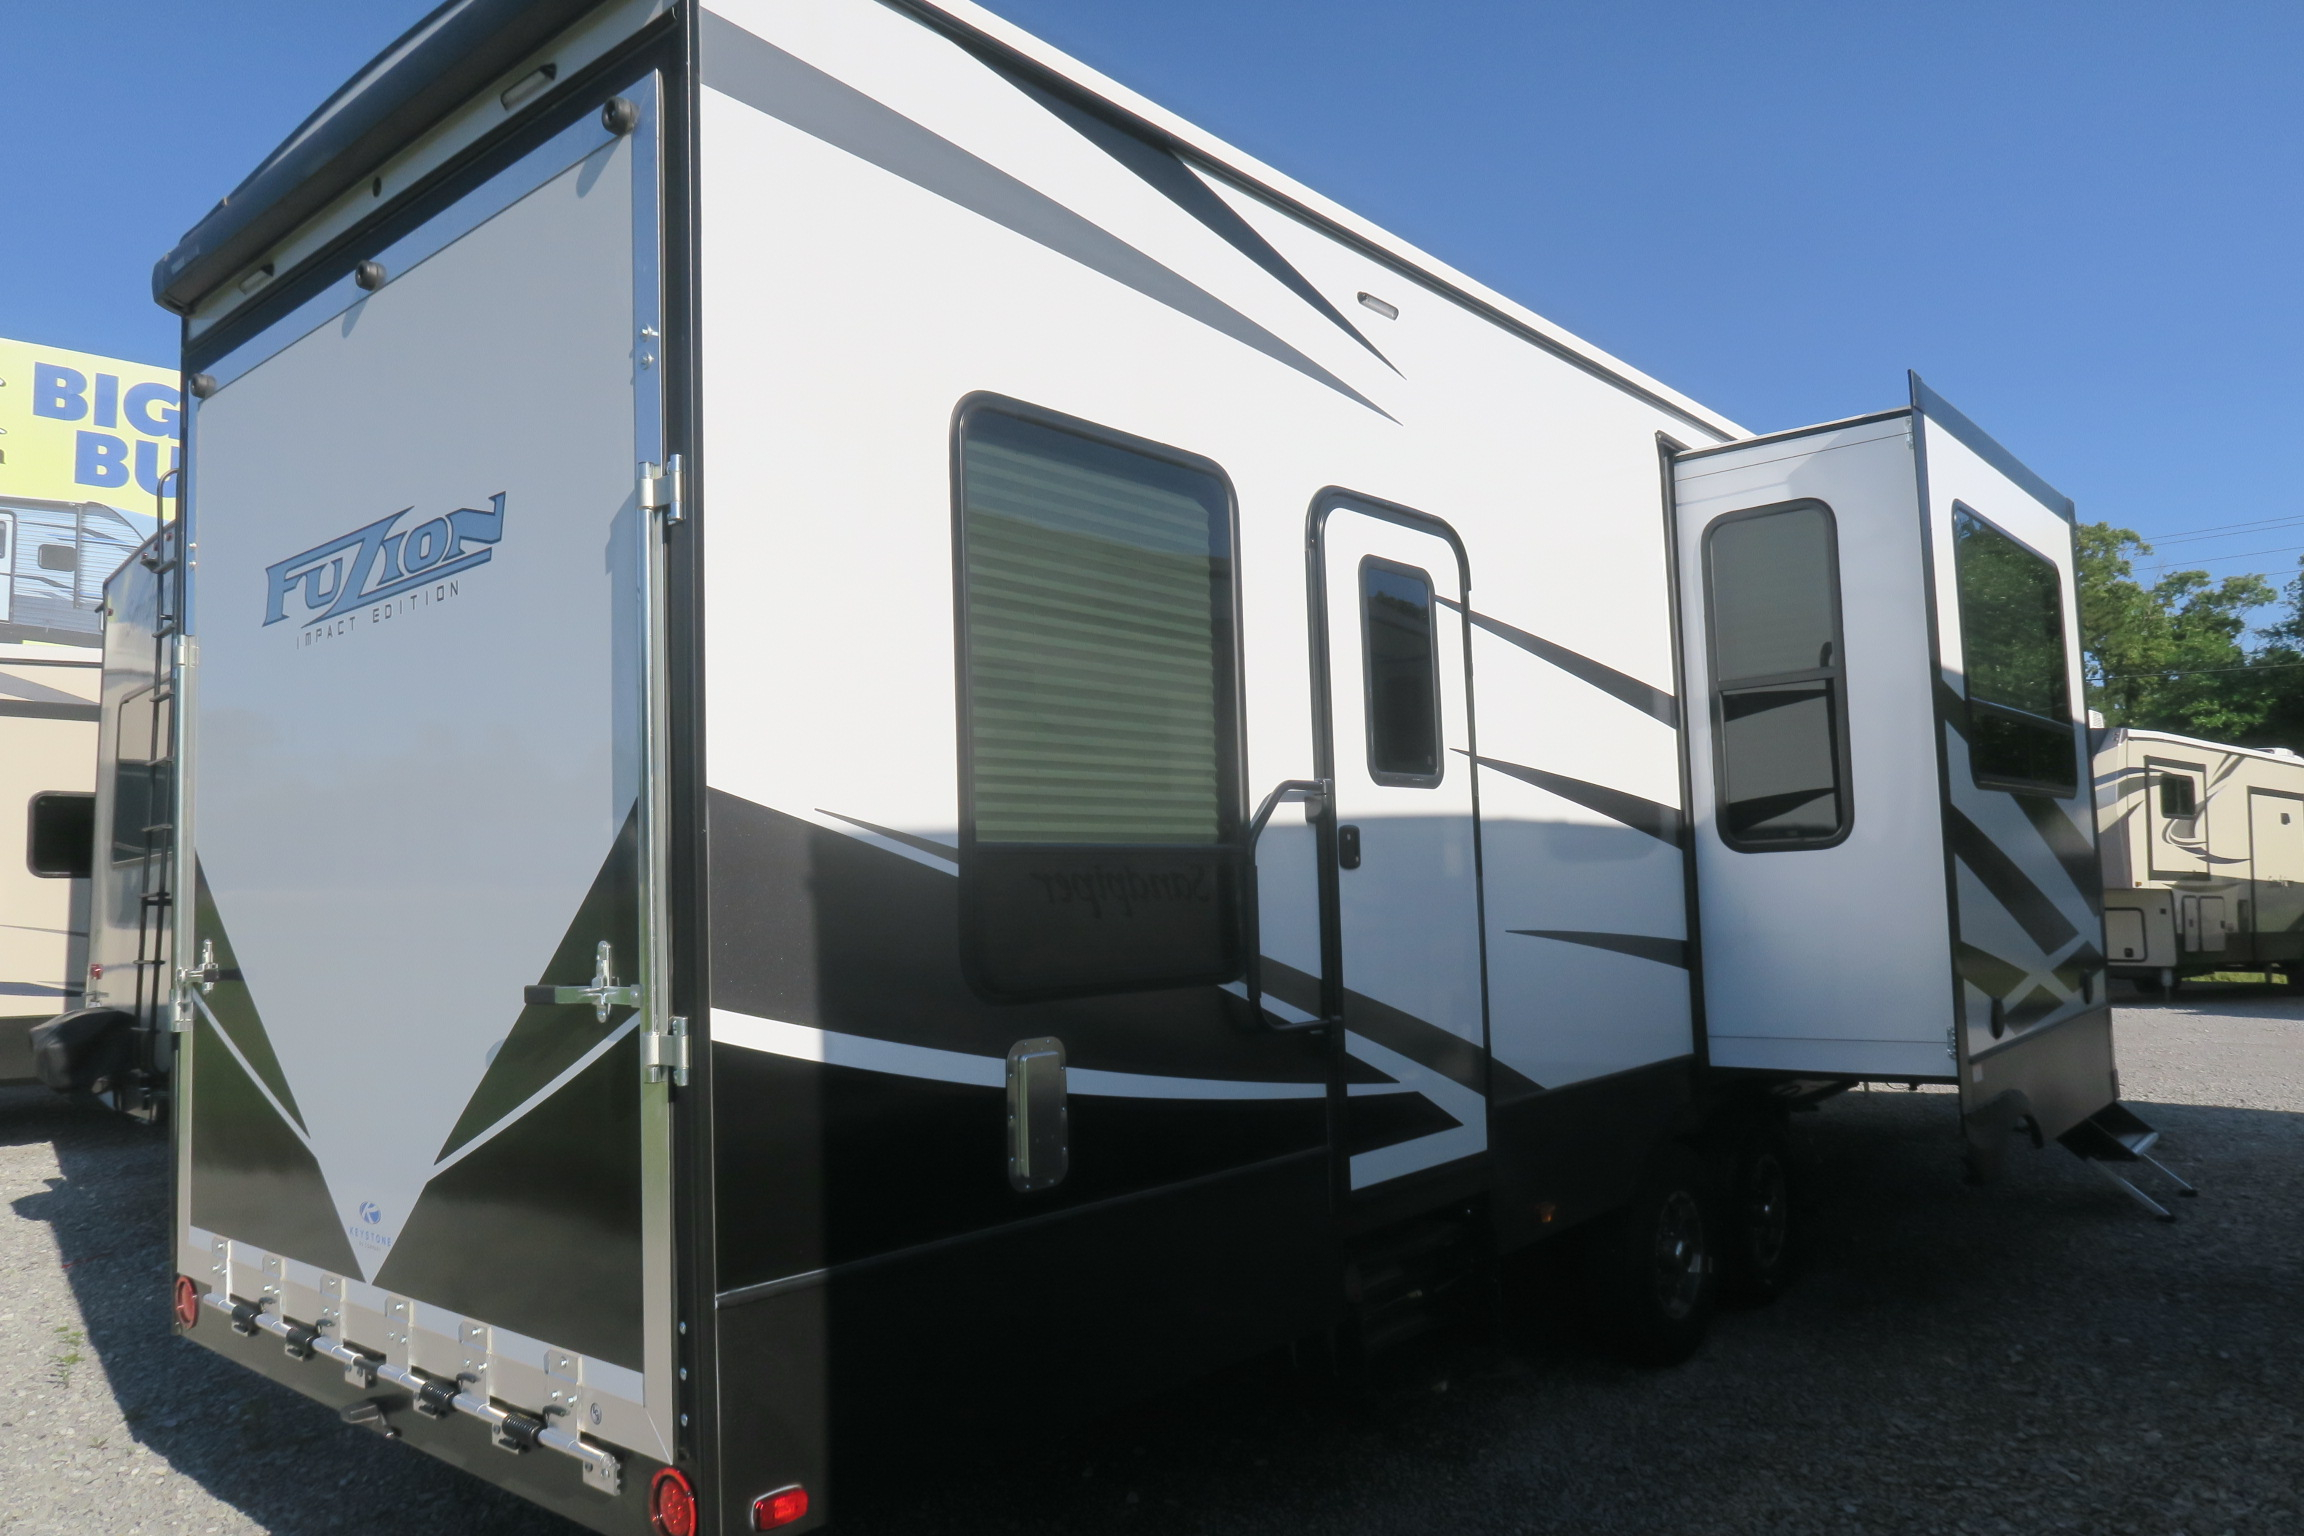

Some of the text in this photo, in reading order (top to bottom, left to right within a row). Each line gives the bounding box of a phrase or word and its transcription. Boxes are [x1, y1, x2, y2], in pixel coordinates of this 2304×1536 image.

[33, 362, 181, 440] BIG
[262, 491, 506, 628] FUZION
[296, 580, 459, 650] IMPACT EDITION
[349, 1226, 392, 1247] KEYSTONE
